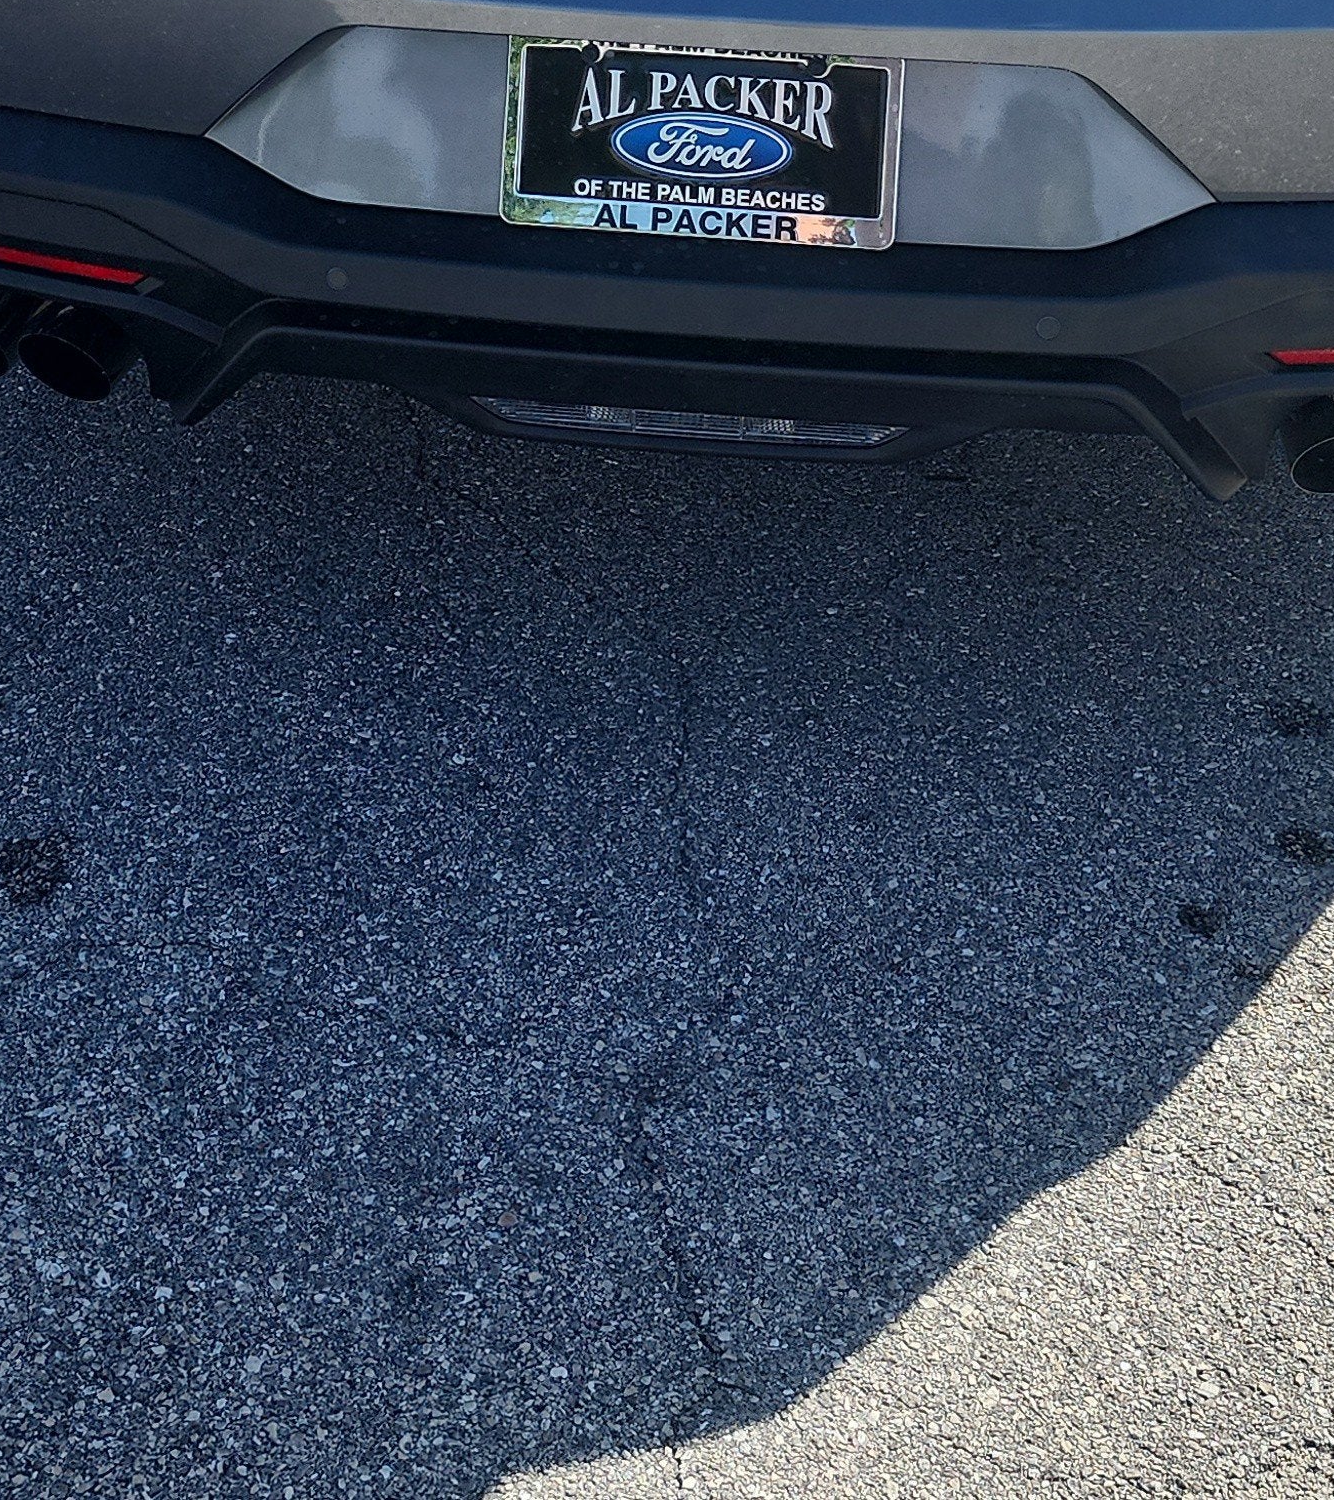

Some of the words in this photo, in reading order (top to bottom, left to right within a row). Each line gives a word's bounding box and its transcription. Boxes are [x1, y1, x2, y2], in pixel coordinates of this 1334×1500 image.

[571, 66, 637, 133] AL
[647, 71, 834, 149] PACKER
[646, 121, 753, 172] Ford
[574, 178, 606, 198] OF
[609, 180, 651, 200] THE
[656, 183, 716, 206] PALM
[721, 187, 826, 211] BEACHES
[593, 202, 639, 230] AL
[650, 205, 799, 242] PACKER
